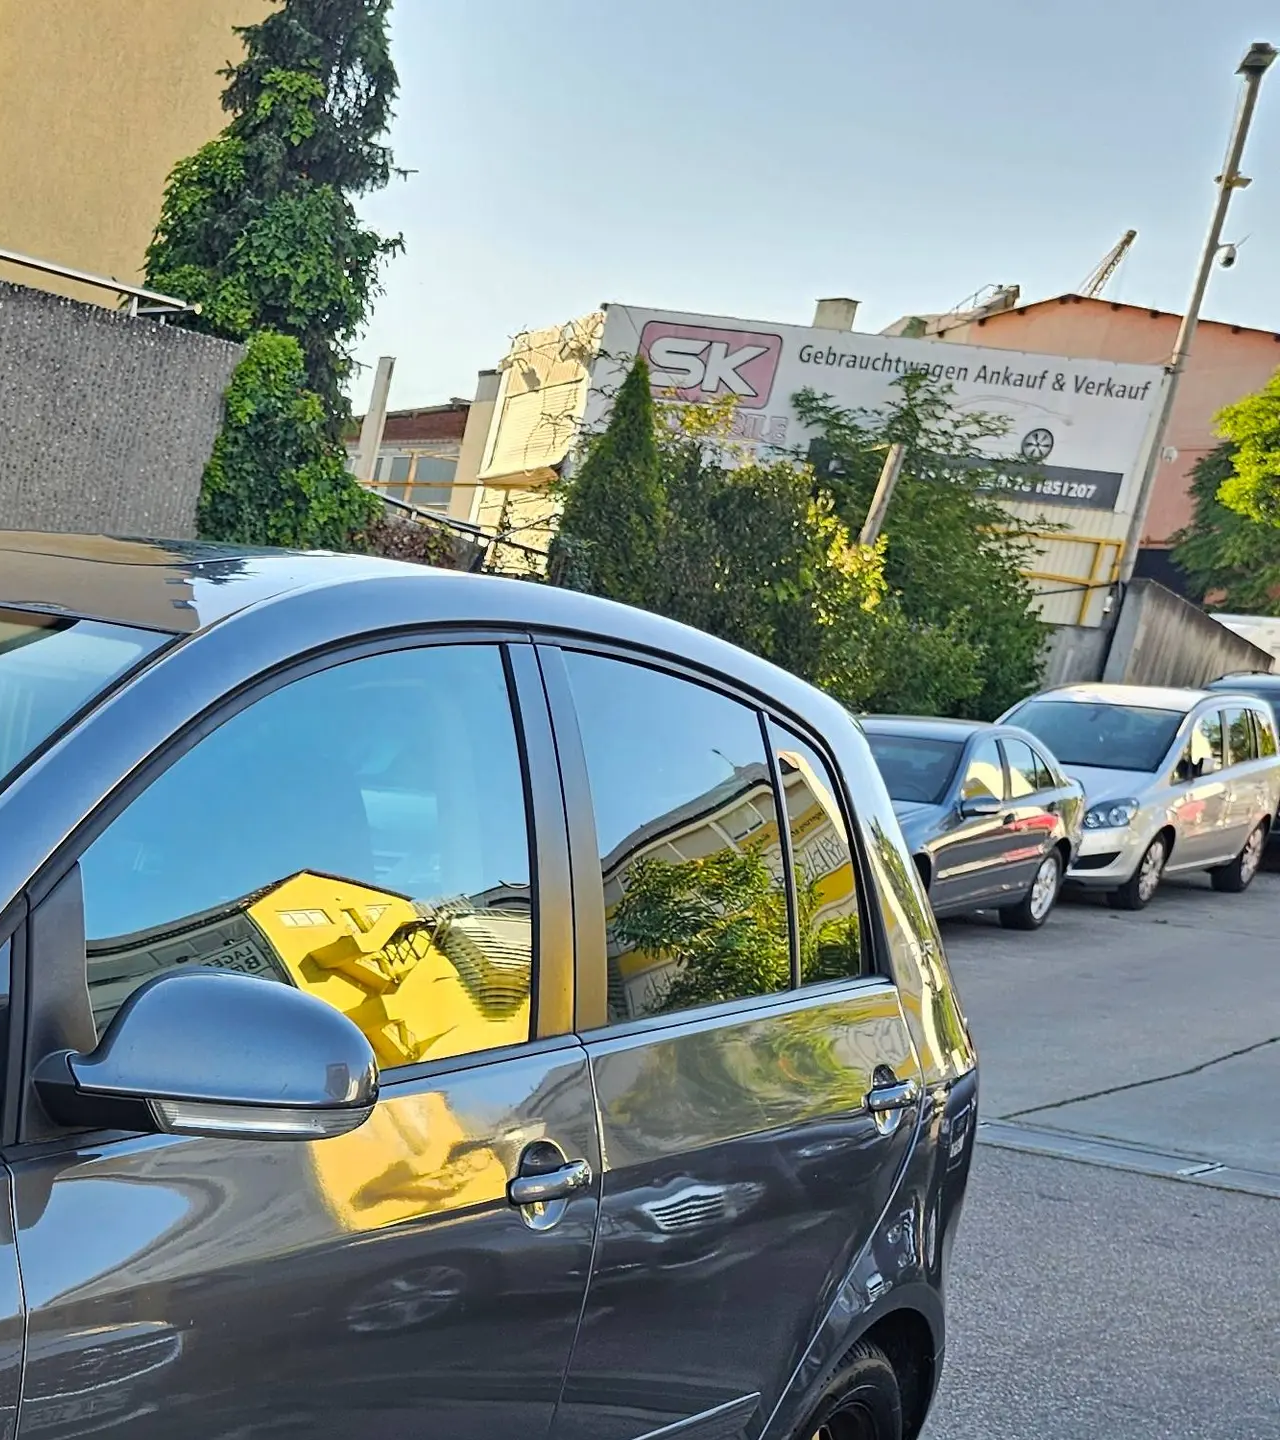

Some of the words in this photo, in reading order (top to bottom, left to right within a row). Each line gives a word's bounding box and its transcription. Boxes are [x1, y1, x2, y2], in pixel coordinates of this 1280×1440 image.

[648, 337, 770, 398] SK
[799, 345, 968, 381] Gebrauchtwagen
[974, 365, 1049, 390] Ankauf
[1052, 373, 1066, 391] &
[1073, 375, 1152, 401] Verkauf
